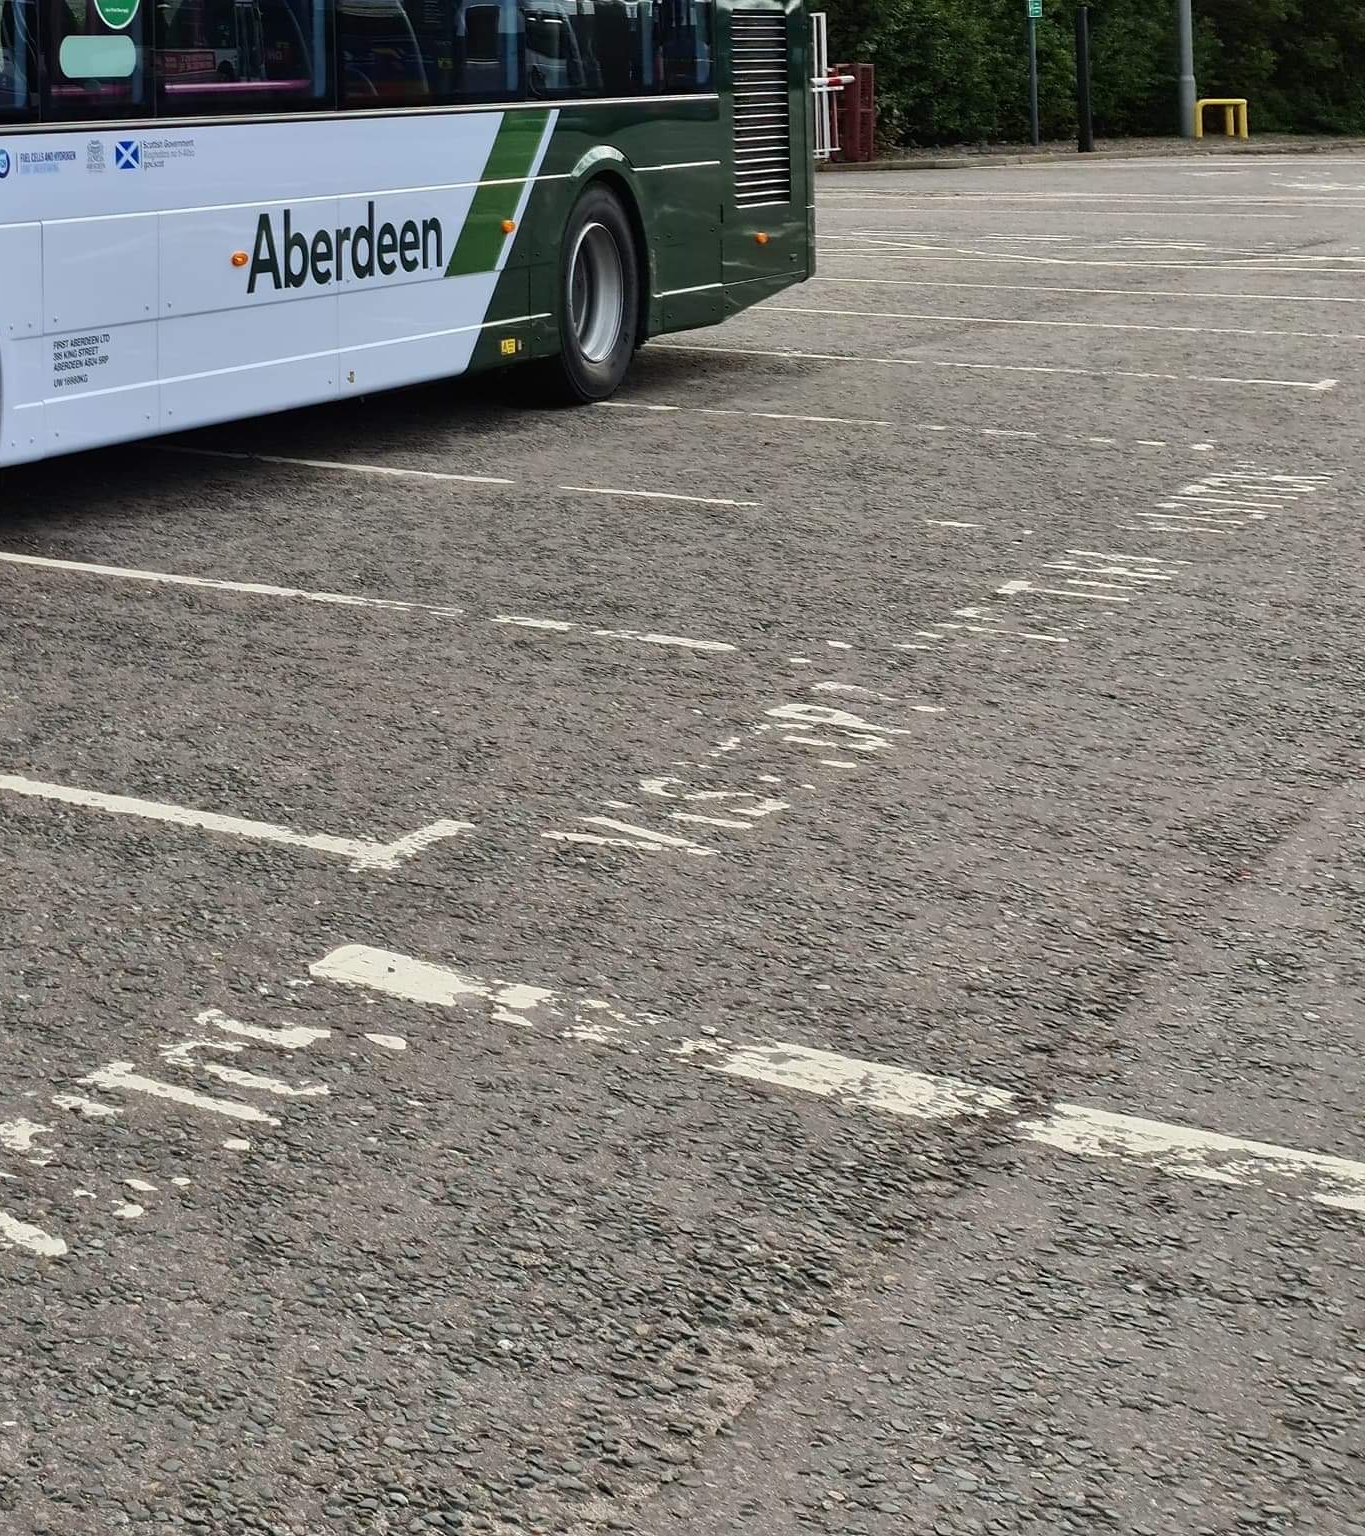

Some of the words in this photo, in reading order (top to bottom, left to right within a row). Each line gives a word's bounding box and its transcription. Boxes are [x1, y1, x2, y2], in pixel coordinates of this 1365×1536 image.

[45, 151, 53, 161] AND
[247, 201, 443, 294] Aberdeen
[53, 340, 69, 350] FIRST
[70, 335, 99, 347] ABERDEEN
[54, 359, 83, 371] ABERDEEN
